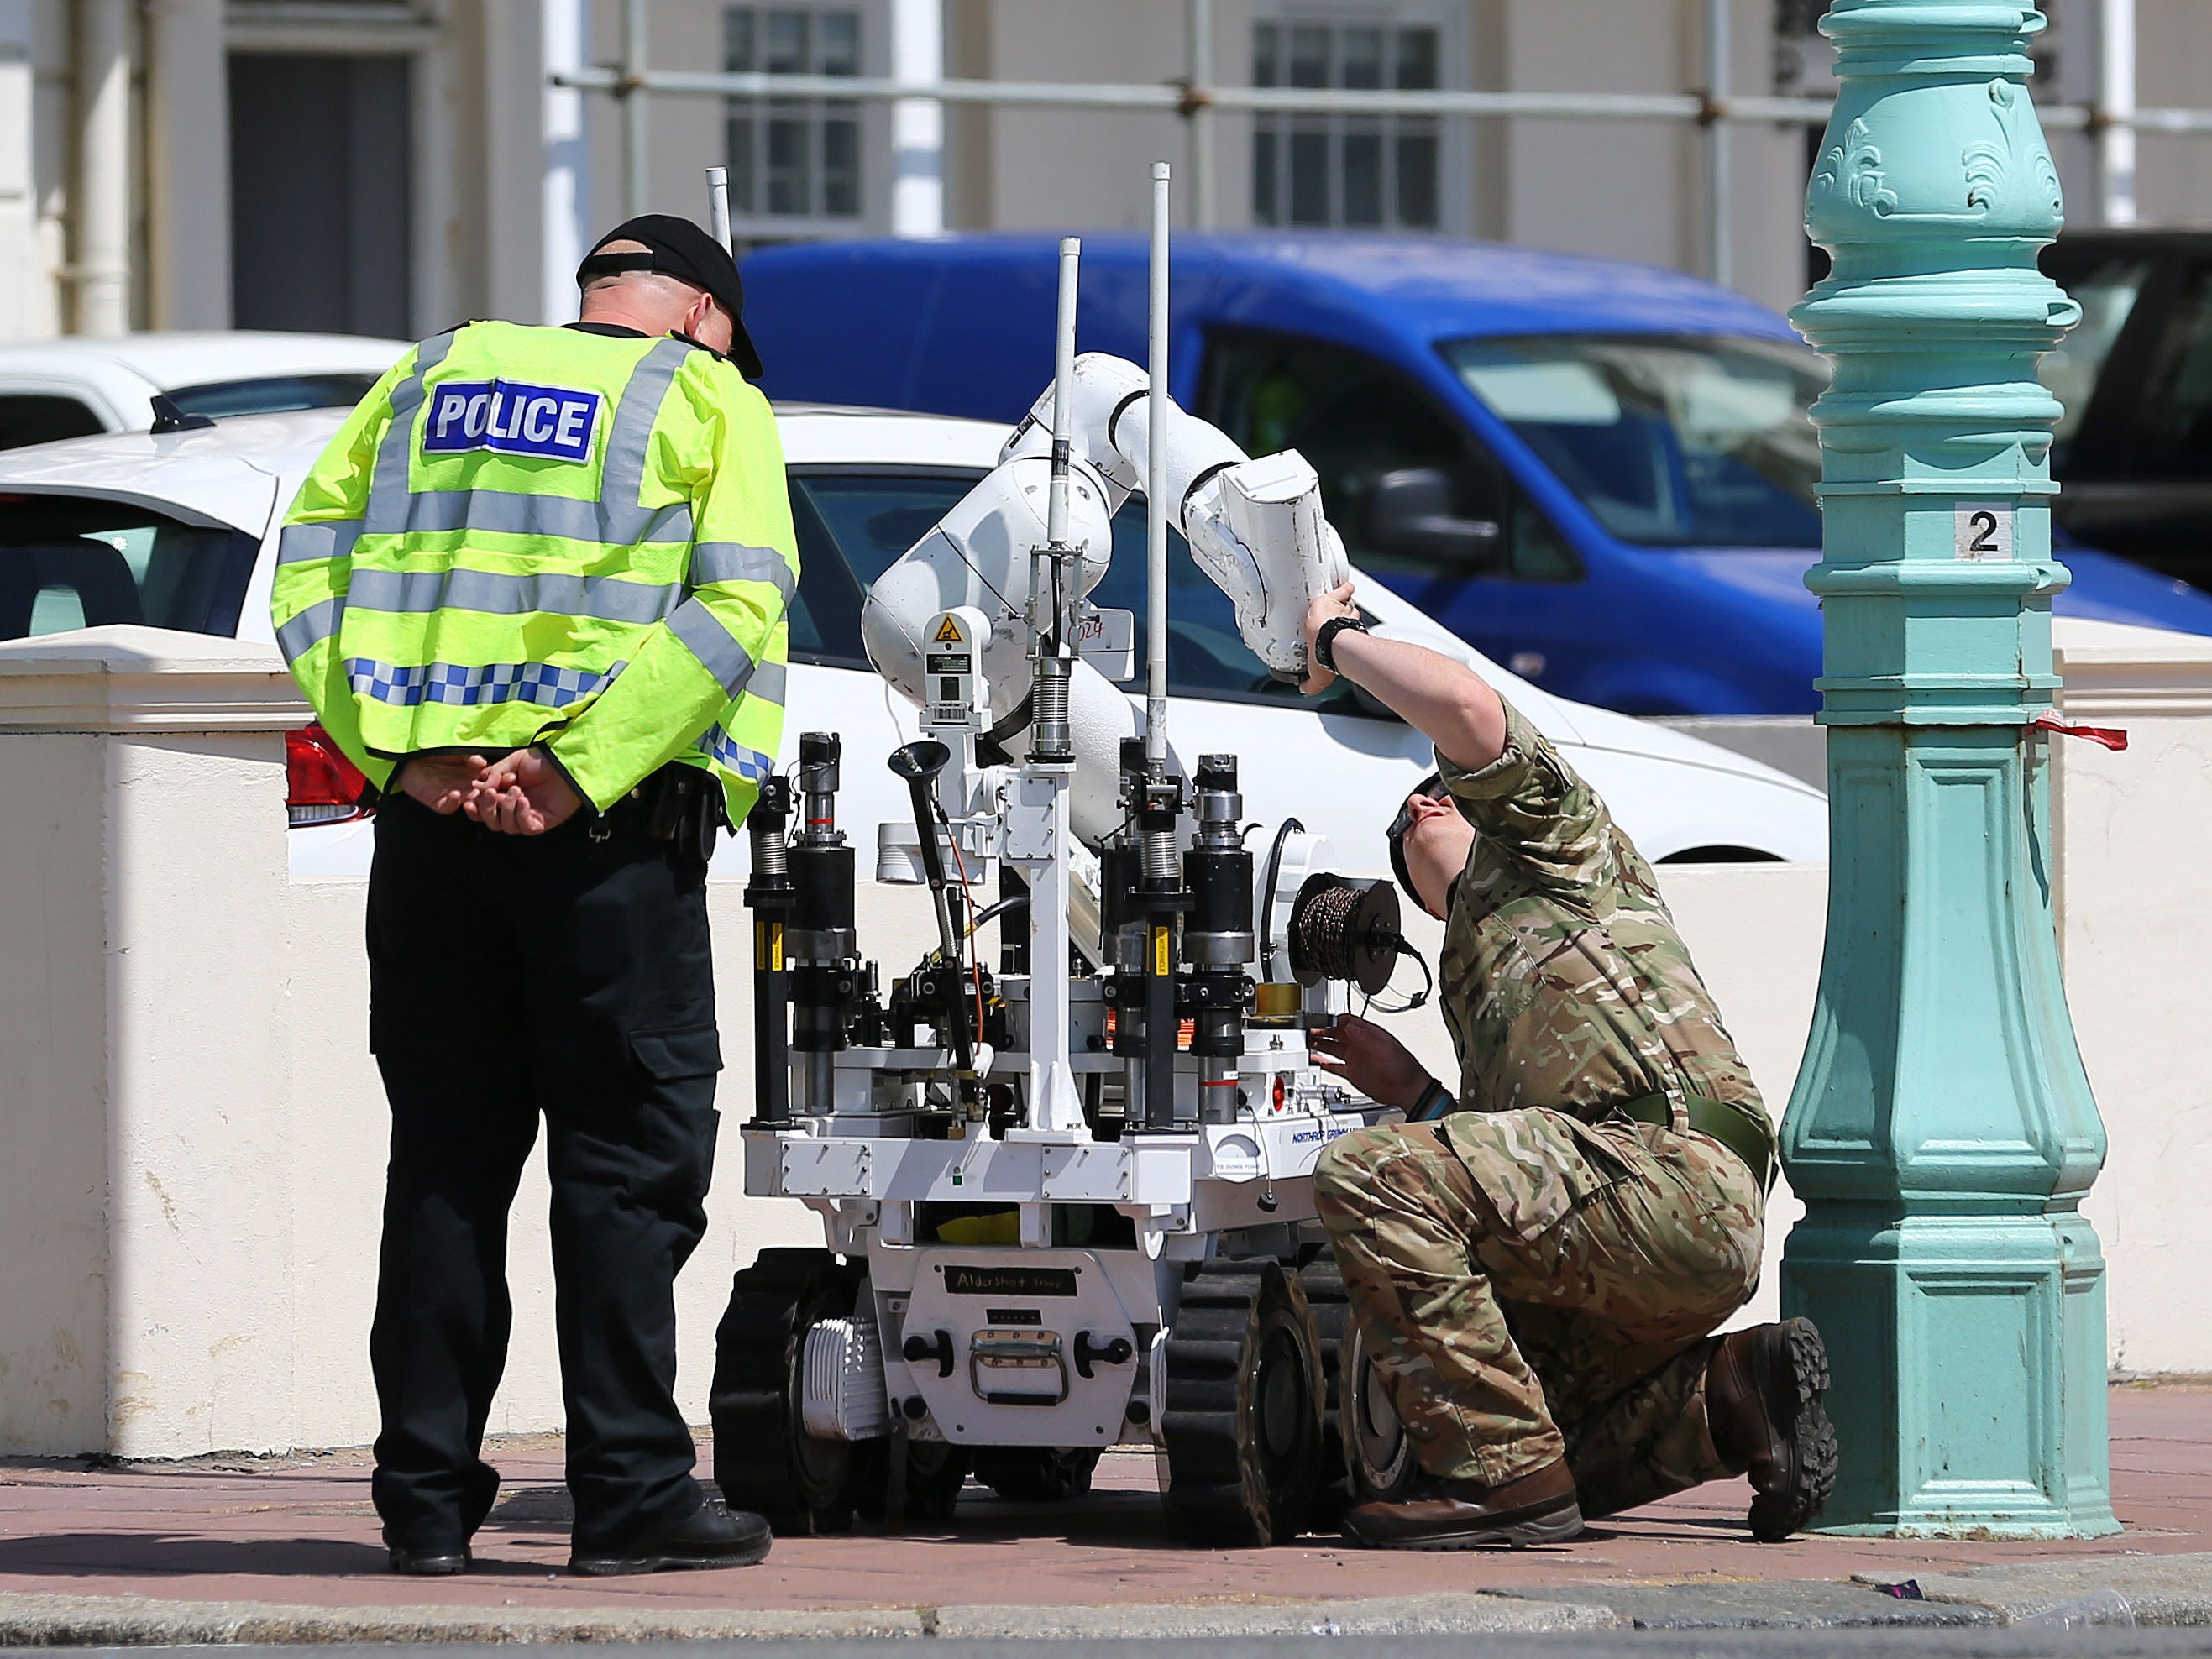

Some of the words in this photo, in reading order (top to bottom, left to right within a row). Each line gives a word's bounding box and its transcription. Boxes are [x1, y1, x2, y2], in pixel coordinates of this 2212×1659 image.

[436, 391, 590, 447] POLICE
[1969, 510, 1999, 552] 2
[1292, 1129, 1325, 1144] NORTHROP
[957, 1272, 1026, 1288] Aldershot
